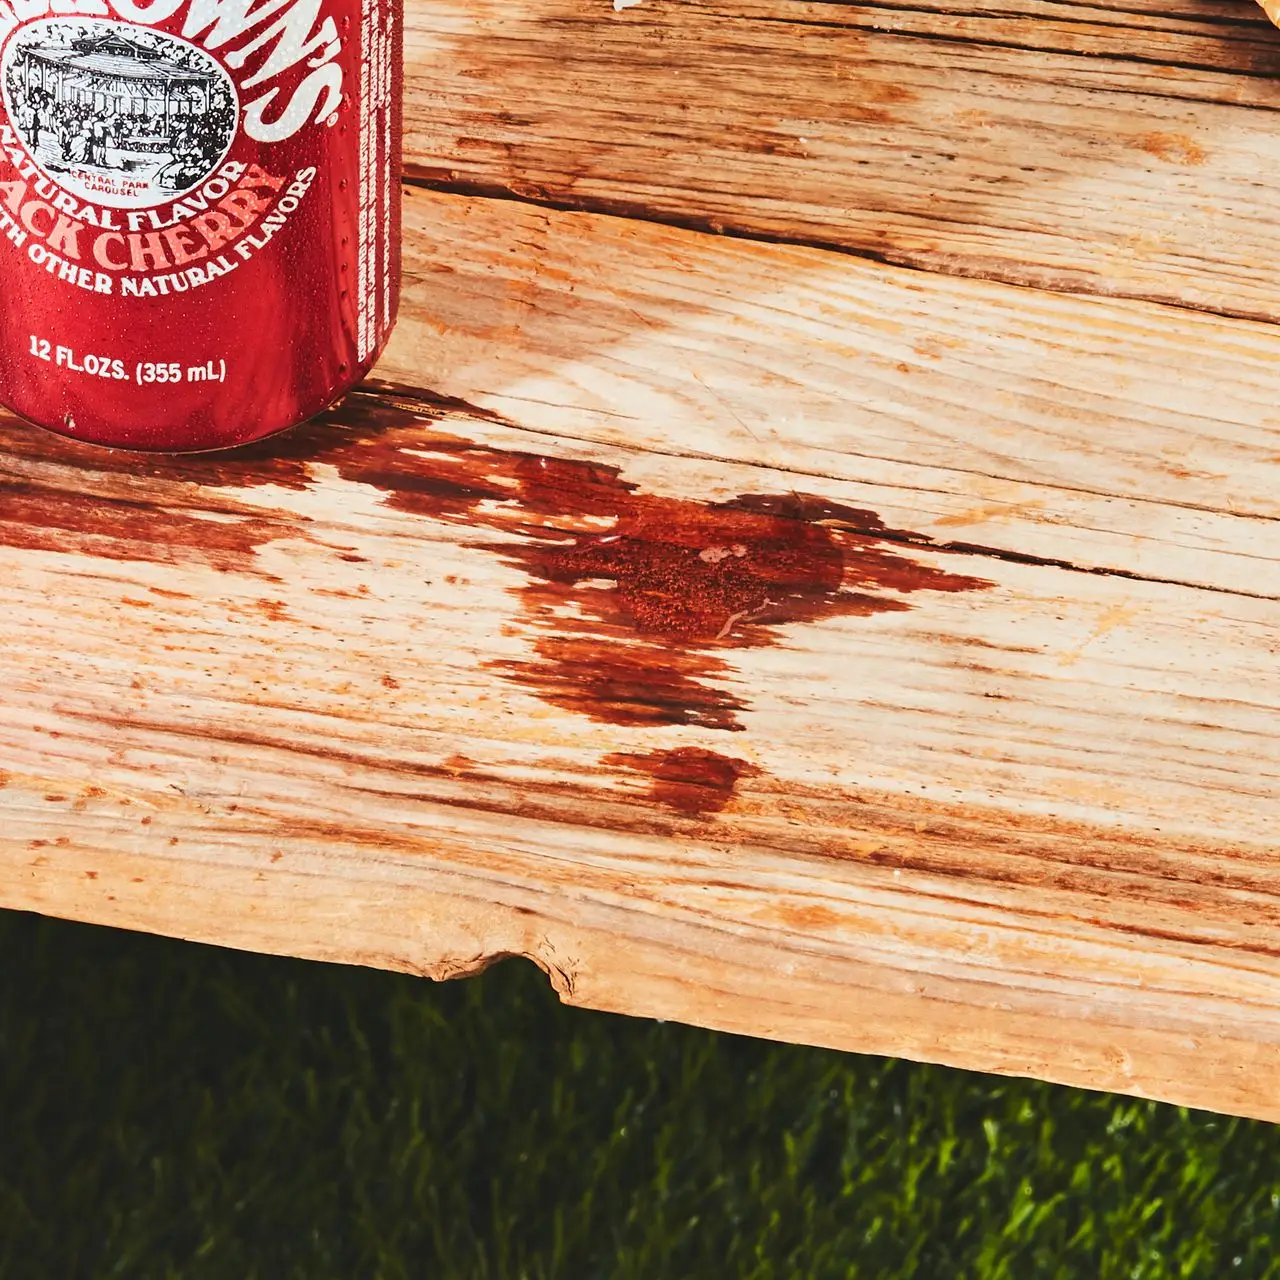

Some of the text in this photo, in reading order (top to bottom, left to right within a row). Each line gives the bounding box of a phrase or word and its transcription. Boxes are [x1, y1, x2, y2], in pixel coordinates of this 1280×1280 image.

[71, 170, 149, 189] CENTRAL PARK
[84, 182, 138, 197] CAROUSEL
[128, 158, 248, 232] FLAVOR
[27, 243, 113, 296] OTHER
[120, 254, 239, 298] NATURAL
[237, 164, 318, 261] FLAVORS
[92, 162, 289, 273] CHERRY
[29, 334, 51, 362] 12
[135, 359, 182, 385] (355
[186, 358, 226, 383] mL)
